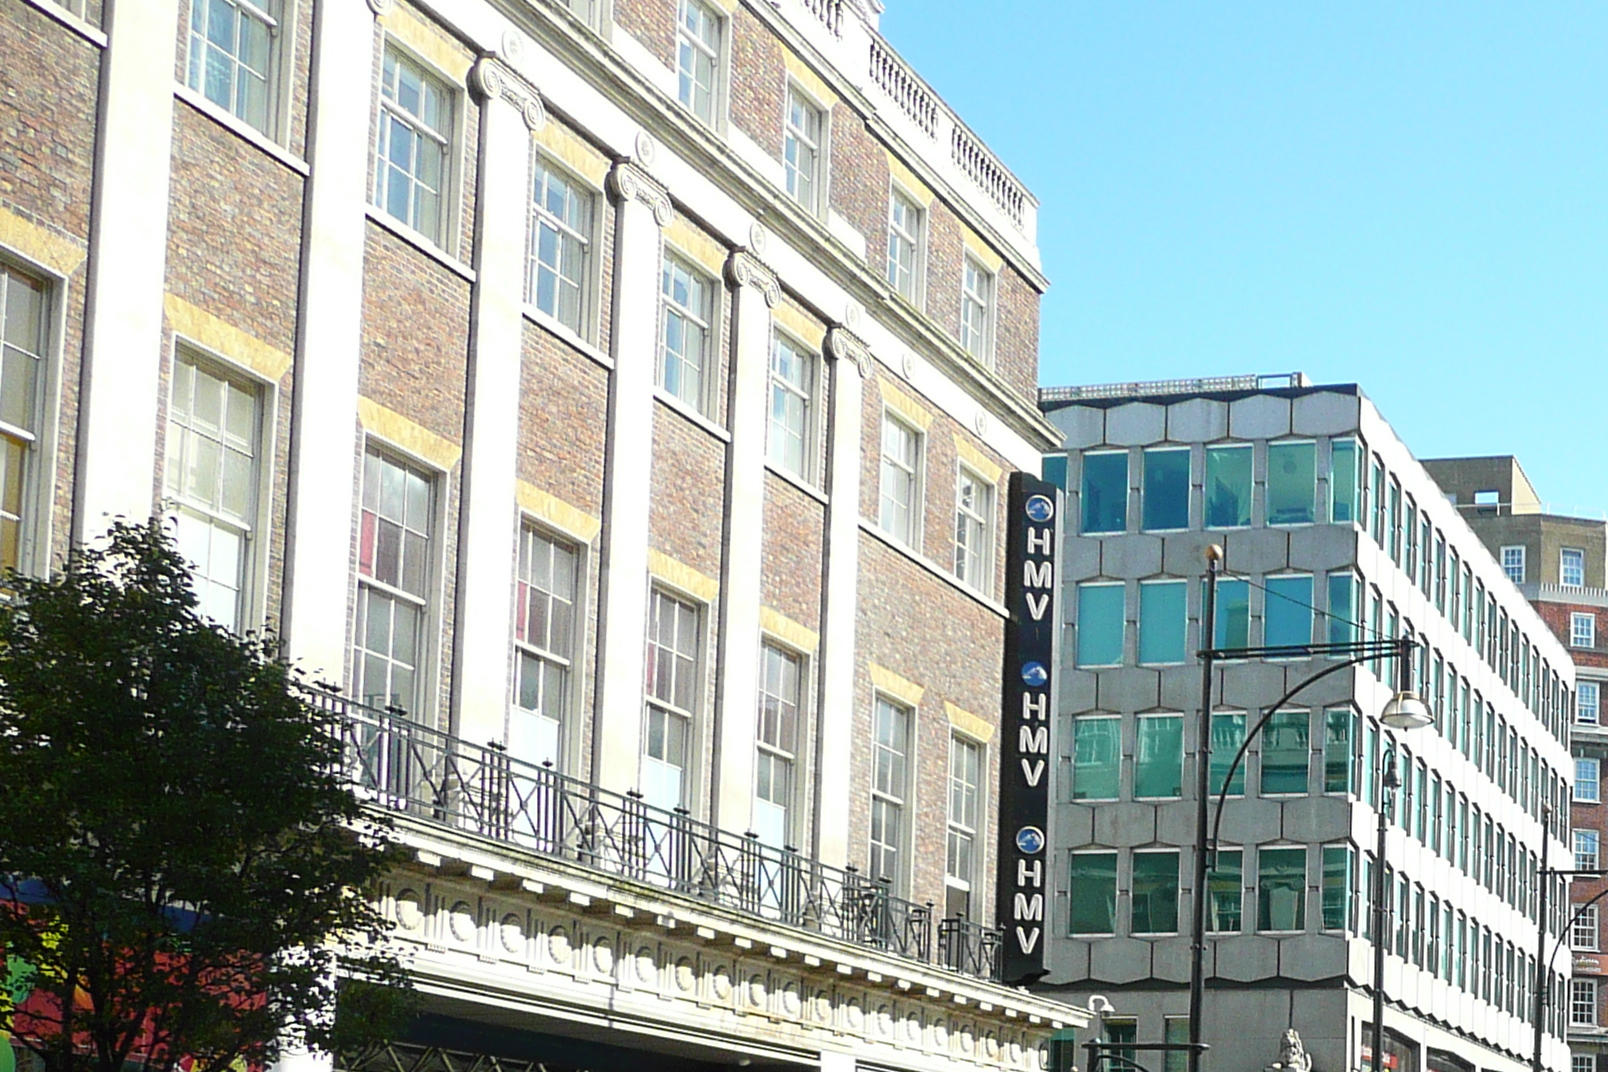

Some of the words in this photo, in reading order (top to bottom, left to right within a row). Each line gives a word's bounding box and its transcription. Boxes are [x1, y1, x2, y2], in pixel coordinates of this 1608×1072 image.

[1023, 526, 1053, 622] HMV
[1018, 691, 1048, 788] HMV
[1013, 858, 1044, 956] HMV
